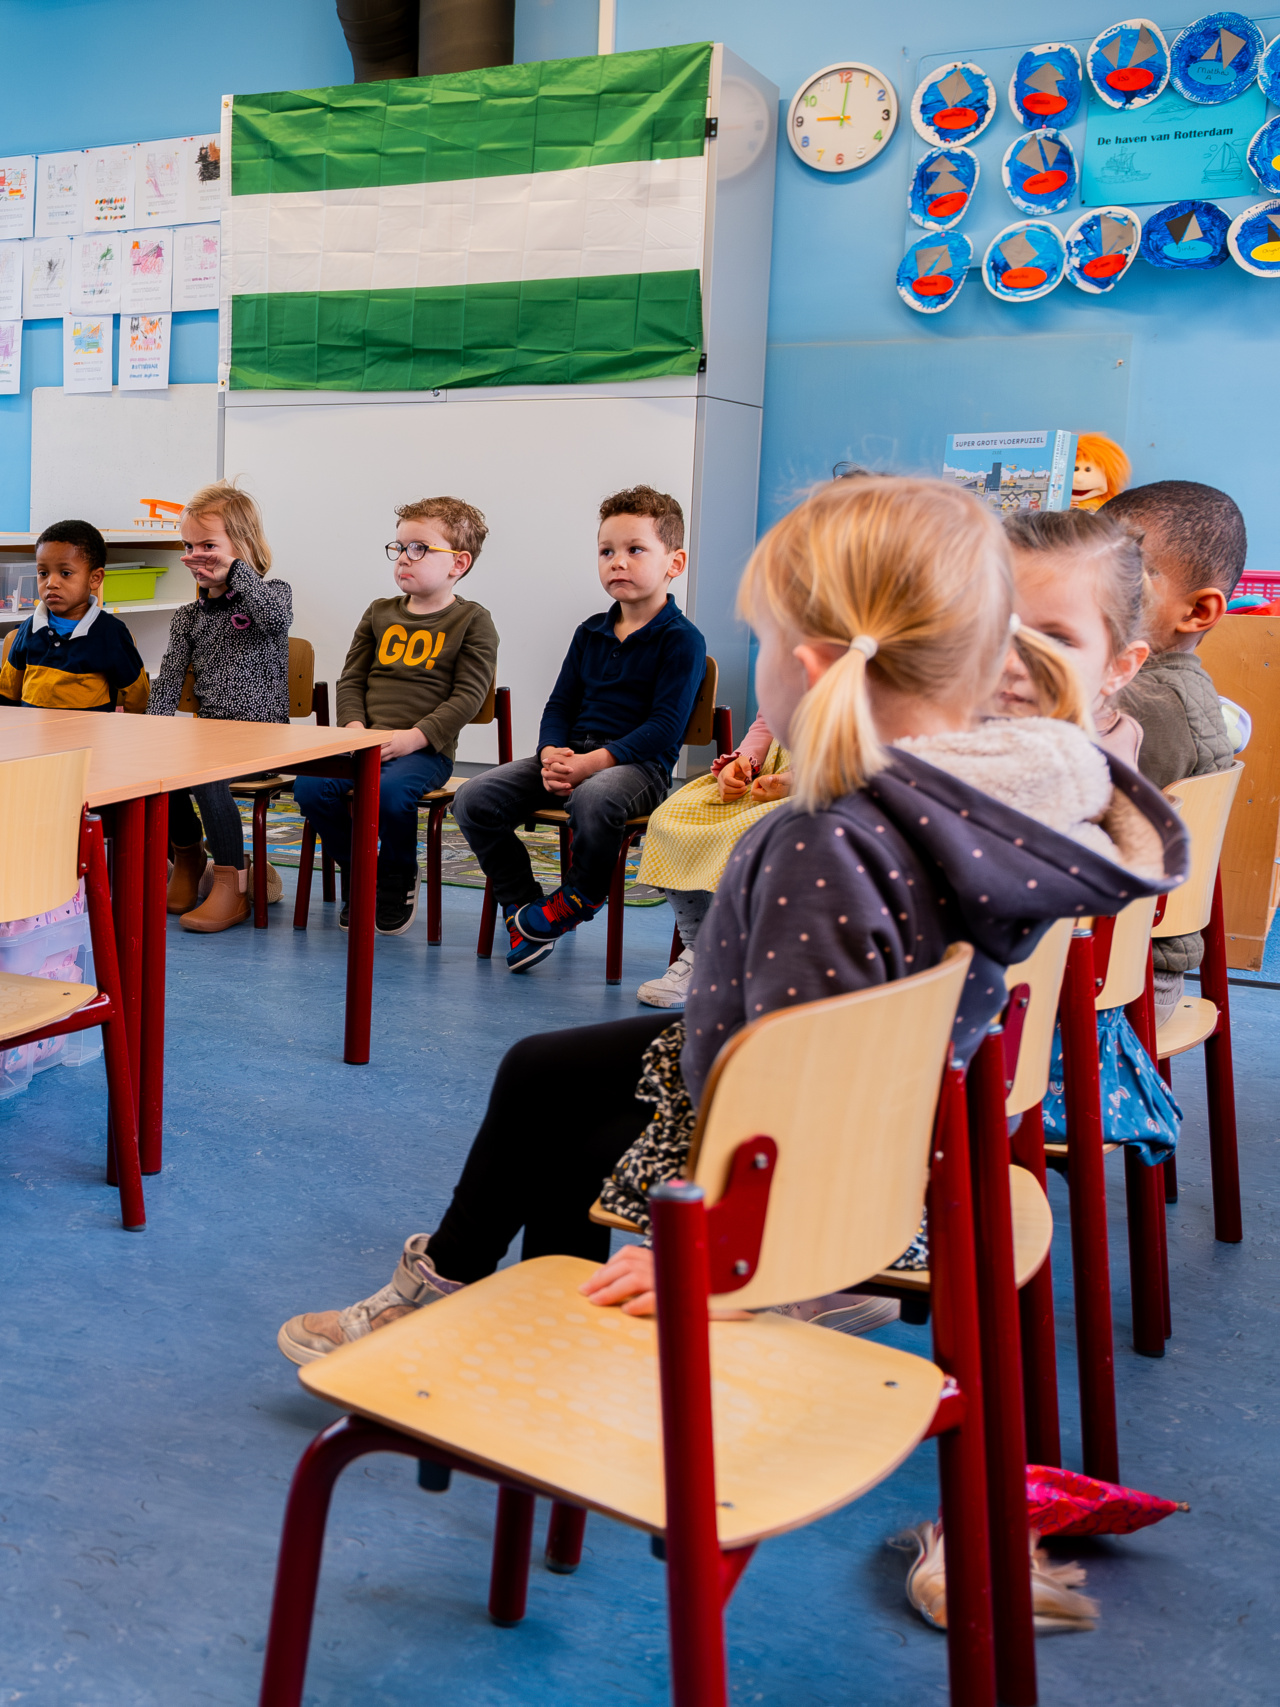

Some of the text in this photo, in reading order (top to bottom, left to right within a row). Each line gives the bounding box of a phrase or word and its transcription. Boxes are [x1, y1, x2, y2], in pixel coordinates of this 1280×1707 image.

[838, 71, 853, 84] 12
[864, 73, 871, 88] 1
[818, 79, 831, 92] 11
[803, 95, 817, 108] 10
[877, 89, 887, 102] 2
[882, 108, 891, 121] 3
[795, 116, 805, 128] 9
[801, 135, 810, 148] 8
[873, 129, 883, 142] 4
[1097, 127, 1234, 146] De haven van Rotterdam
[816, 148, 825, 162] 7
[835, 153, 845, 166] 6
[856, 146, 866, 160] 5
[955, 437, 1045, 448] SUPER GROTE VLOERPUZZEL
[378, 624, 446, 671] GO!
